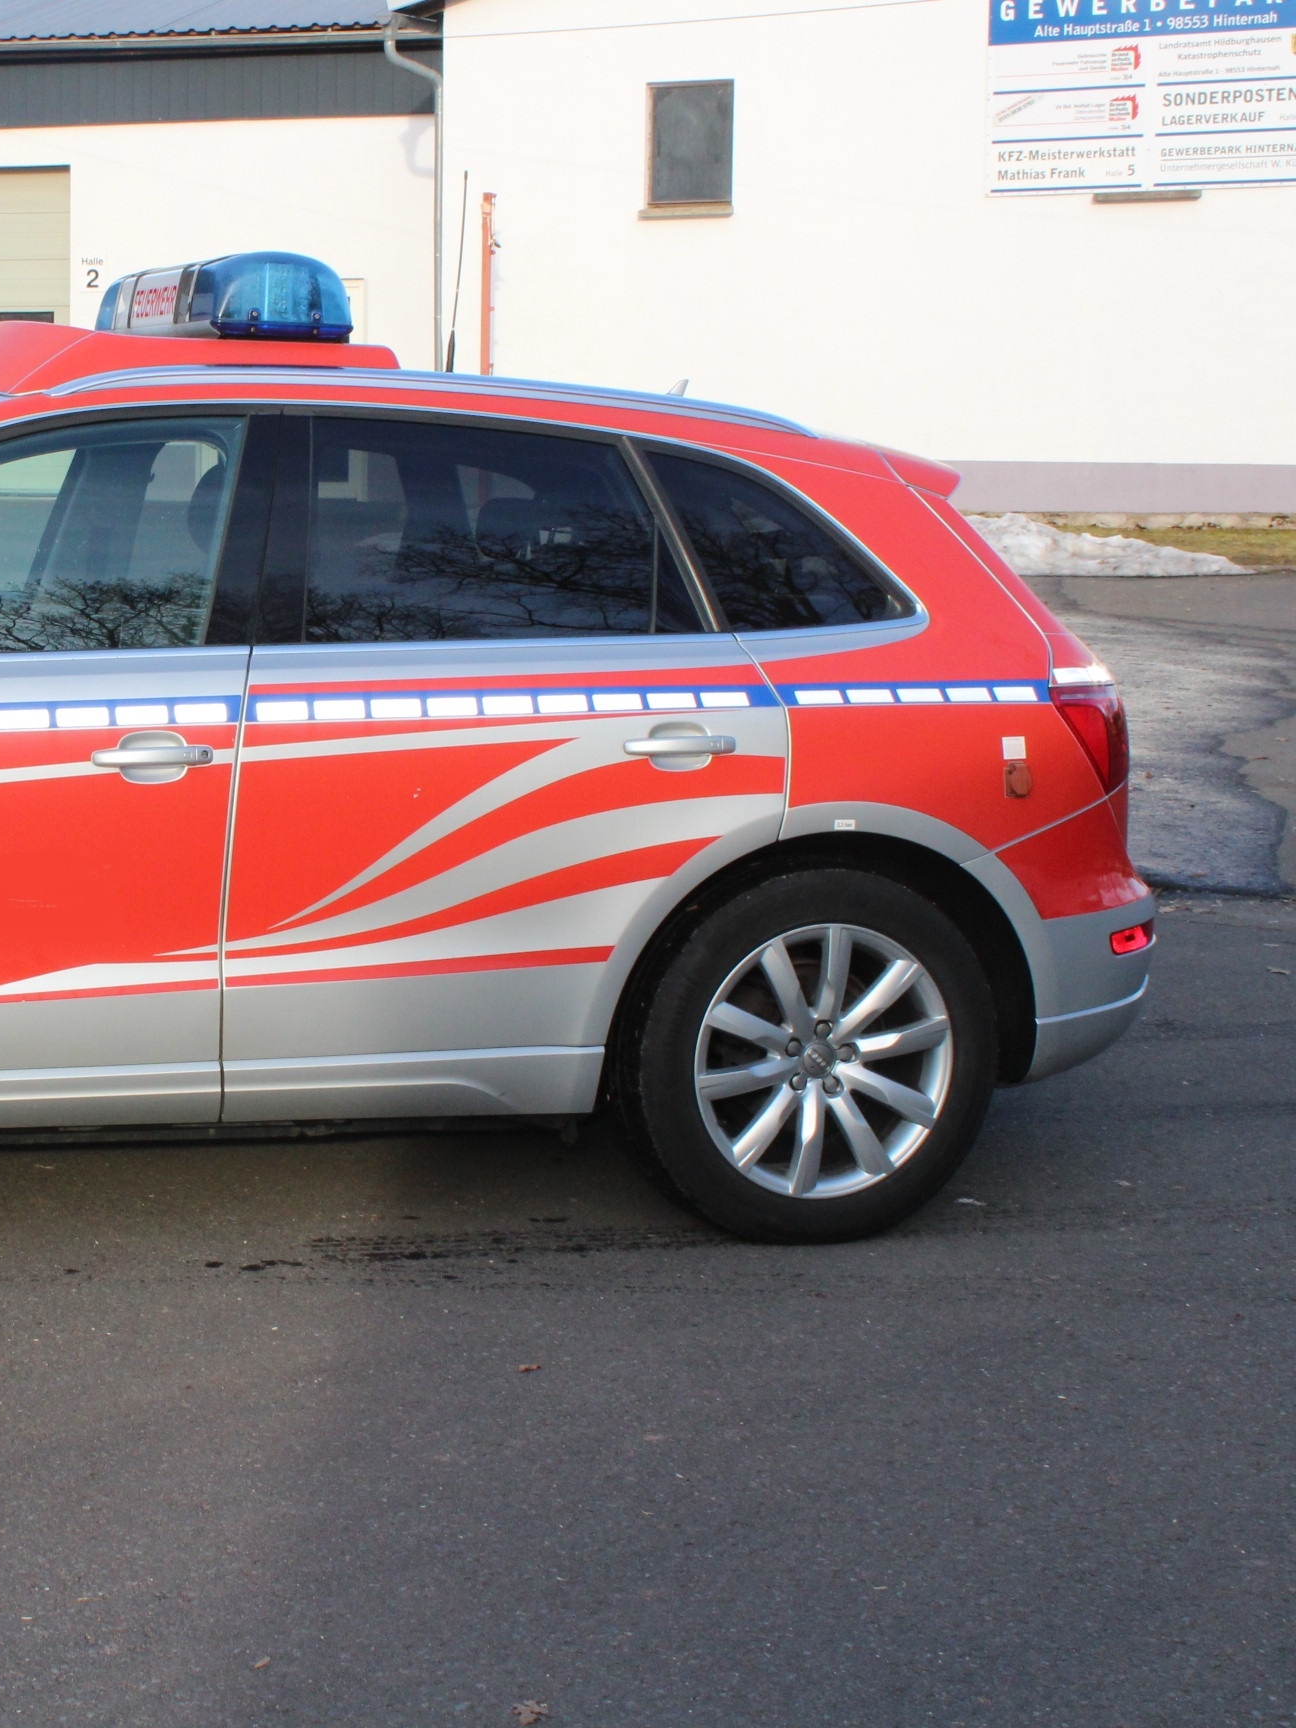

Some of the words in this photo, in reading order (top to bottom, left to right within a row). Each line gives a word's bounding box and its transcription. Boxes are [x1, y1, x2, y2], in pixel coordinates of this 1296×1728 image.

[1034, 24, 1060, 38] Alte
[1064, 20, 1140, 37] Hauptstraße
[1143, 19, 1151, 31] 1
[1166, 15, 1209, 30] 98553
[1213, 11, 1278, 27] Hinternah
[1158, 40, 1212, 50] Landratsamt
[1213, 35, 1282, 47] Hildburghausen
[1177, 49, 1262, 61] Katastrophenschutz
[1172, 68, 1214, 78] Hauptstraße
[1162, 87, 1296, 107] SONDERPOSTEN
[1161, 111, 1266, 127] LAGERVERKAUF
[997, 145, 1136, 163] KFZ-Meisterwerkstatt
[1160, 145, 1242, 157] GEWERBEPARK
[1245, 143, 1296, 154] HINTERN
[997, 169, 1046, 181] Mathias
[1050, 167, 1086, 180] Frank
[1105, 169, 1123, 177] Halle
[1127, 164, 1136, 176] 5
[1159, 159, 1268, 173] Unternehmergesellschaft
[1270, 159, 1283, 168] W.
[81, 257, 104, 266] Halle
[86, 269, 99, 288] 2
[132, 285, 177, 318] FEUERWEHR
